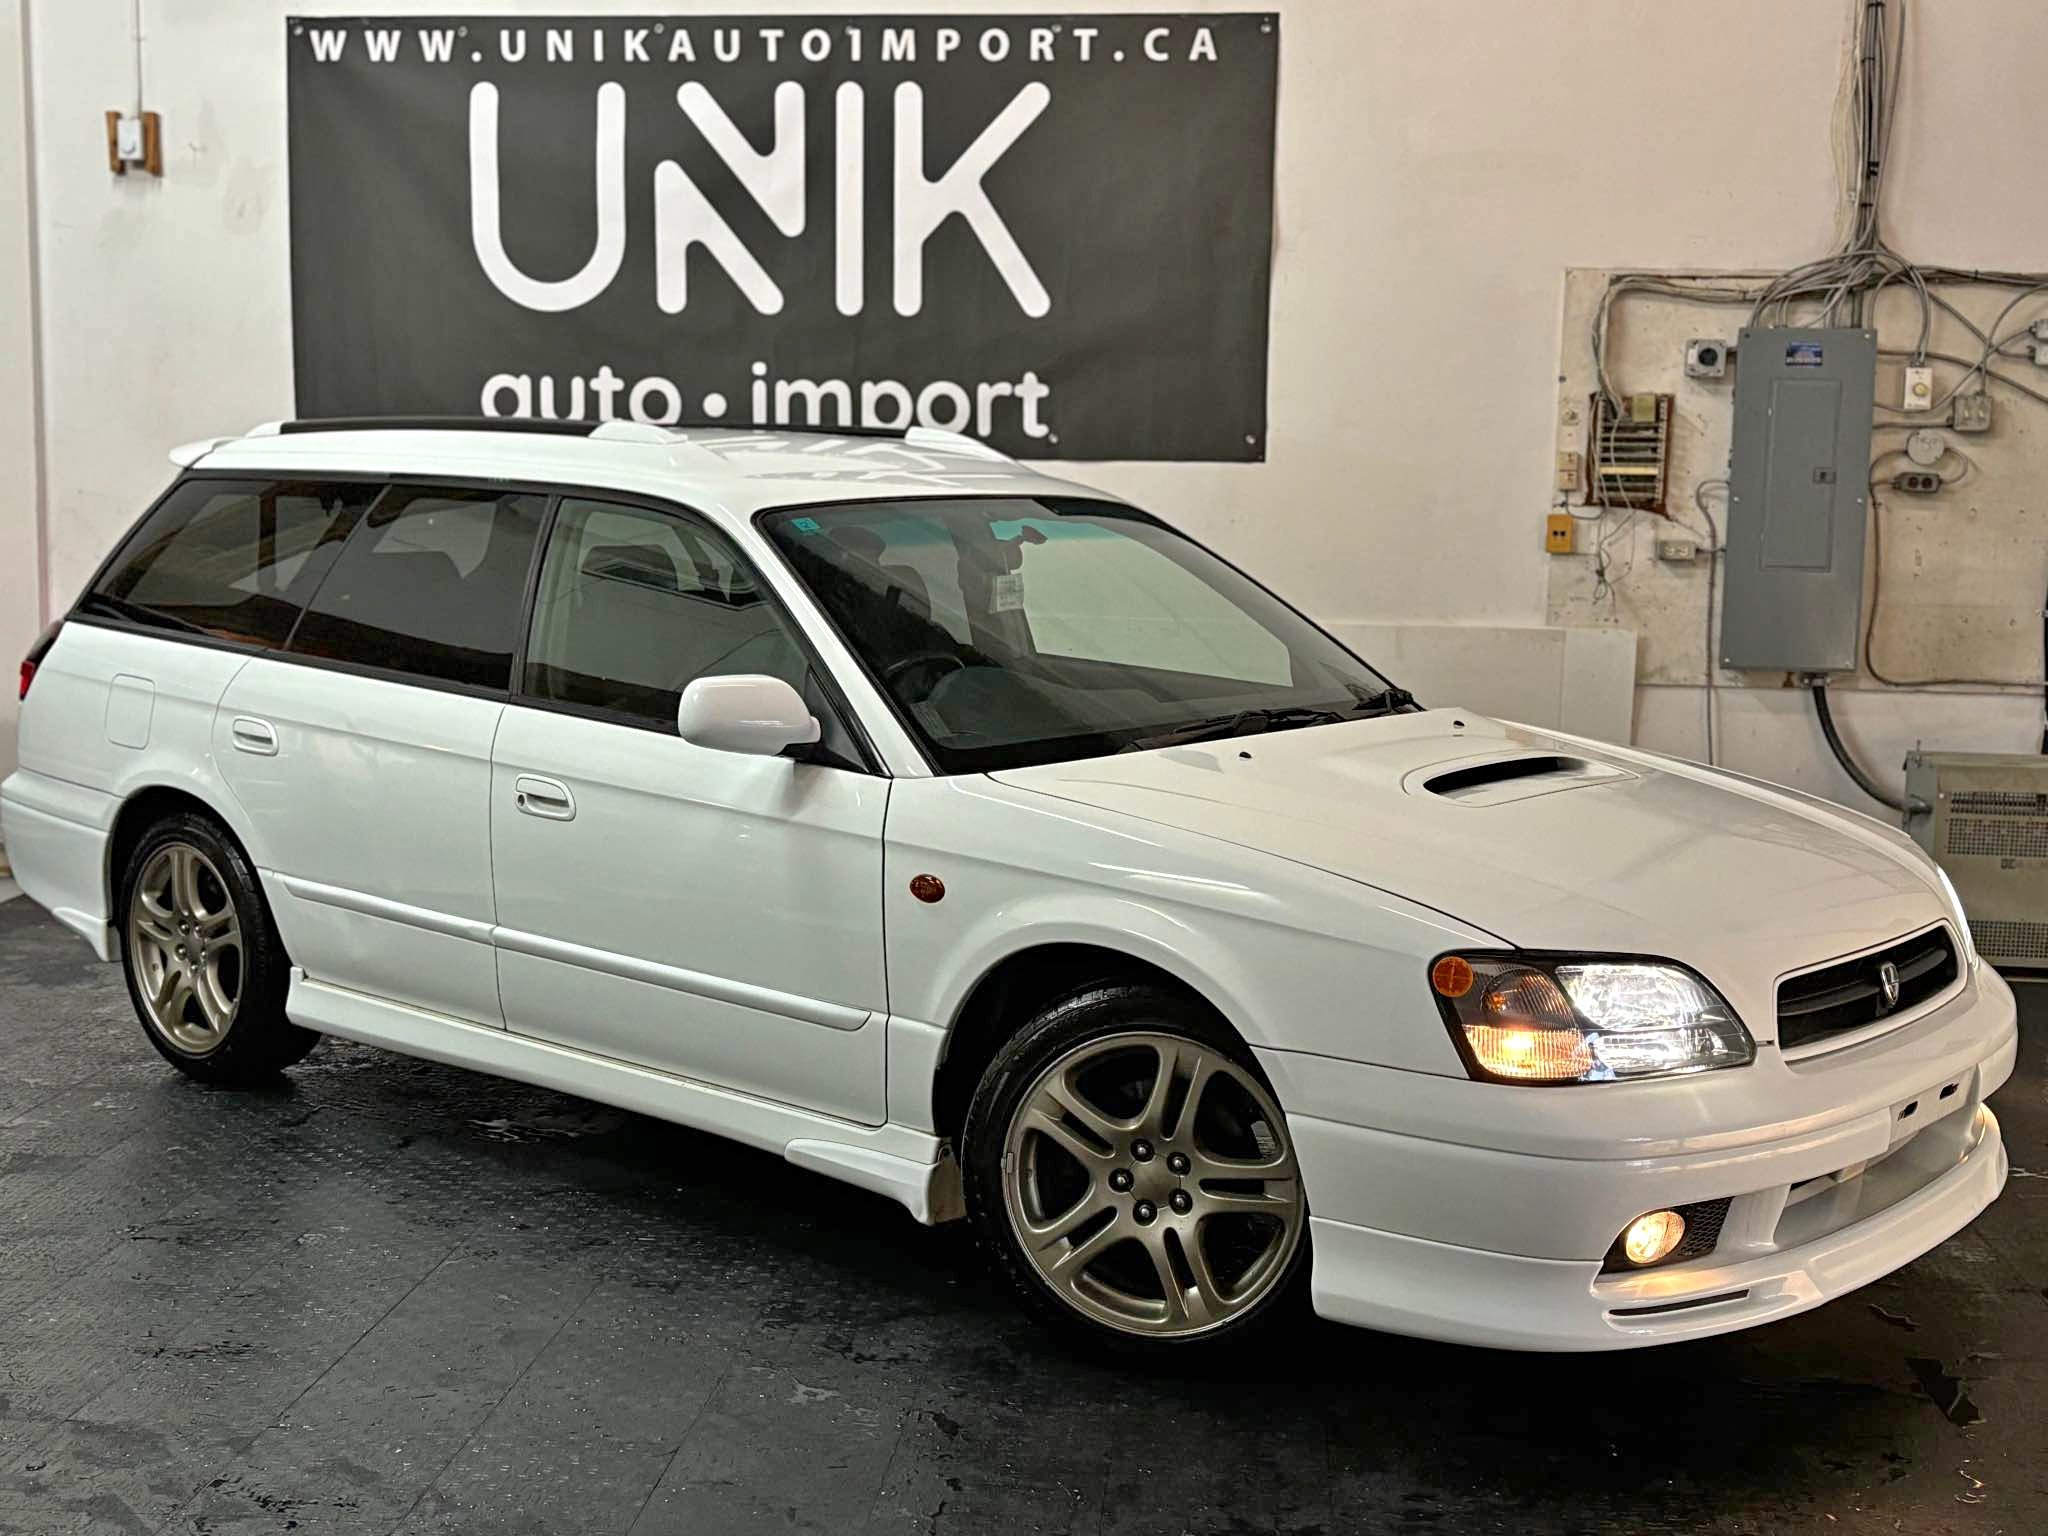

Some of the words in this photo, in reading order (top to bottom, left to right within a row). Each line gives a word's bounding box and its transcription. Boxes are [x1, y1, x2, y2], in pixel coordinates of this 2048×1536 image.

[309, 28, 1218, 63] WWW.UNIKAUTOIMPORT.CA
[469, 80, 1051, 318] UNIK
[481, 365, 683, 425] auto
[751, 361, 1050, 438] import
